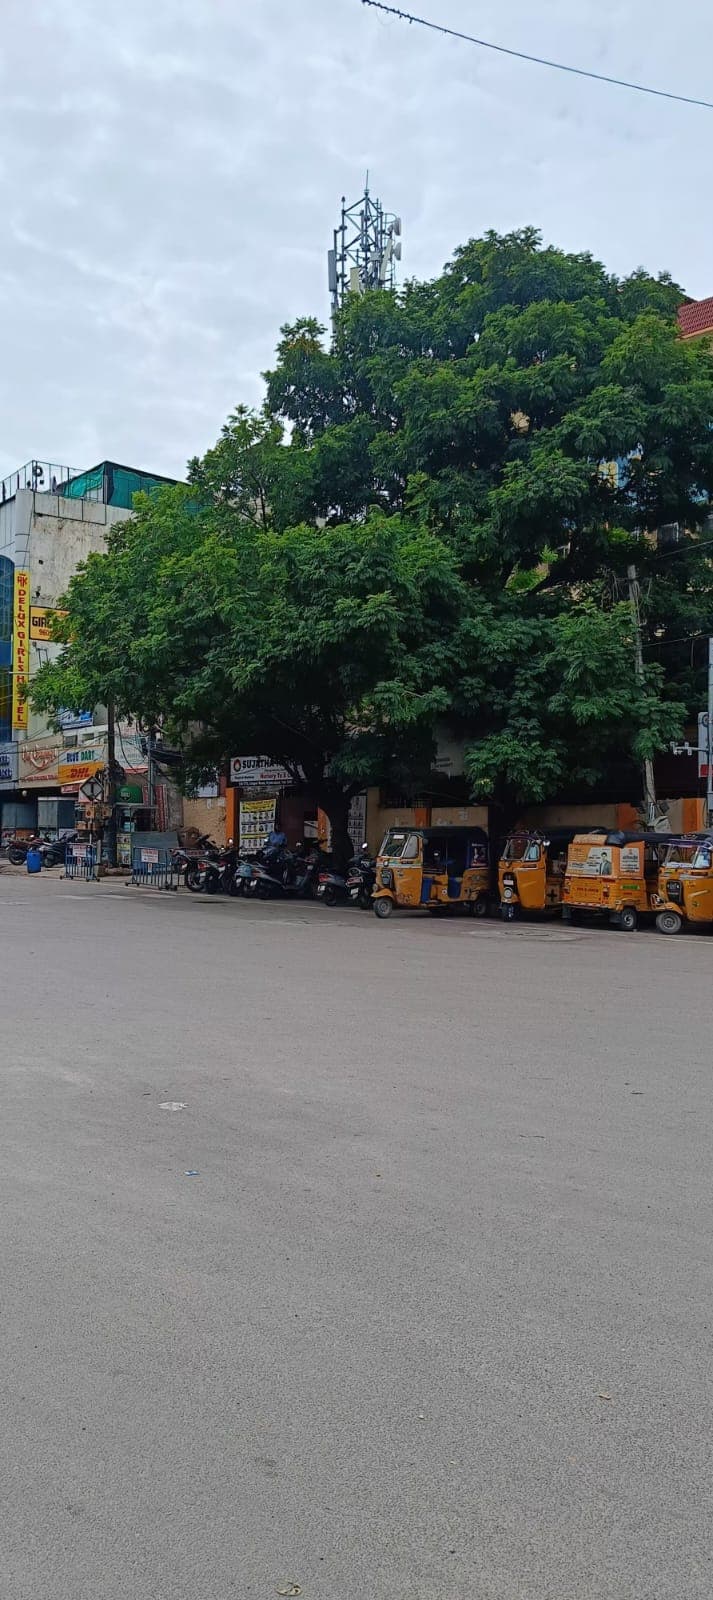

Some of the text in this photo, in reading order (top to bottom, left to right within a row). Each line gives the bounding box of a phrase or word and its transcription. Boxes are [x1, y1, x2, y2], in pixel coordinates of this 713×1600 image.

[17, 631, 26, 672] GIRLS
[16, 675, 26, 722] HSTEL
[80, 750, 95, 761] DART
[70, 767, 90, 778] DHL
